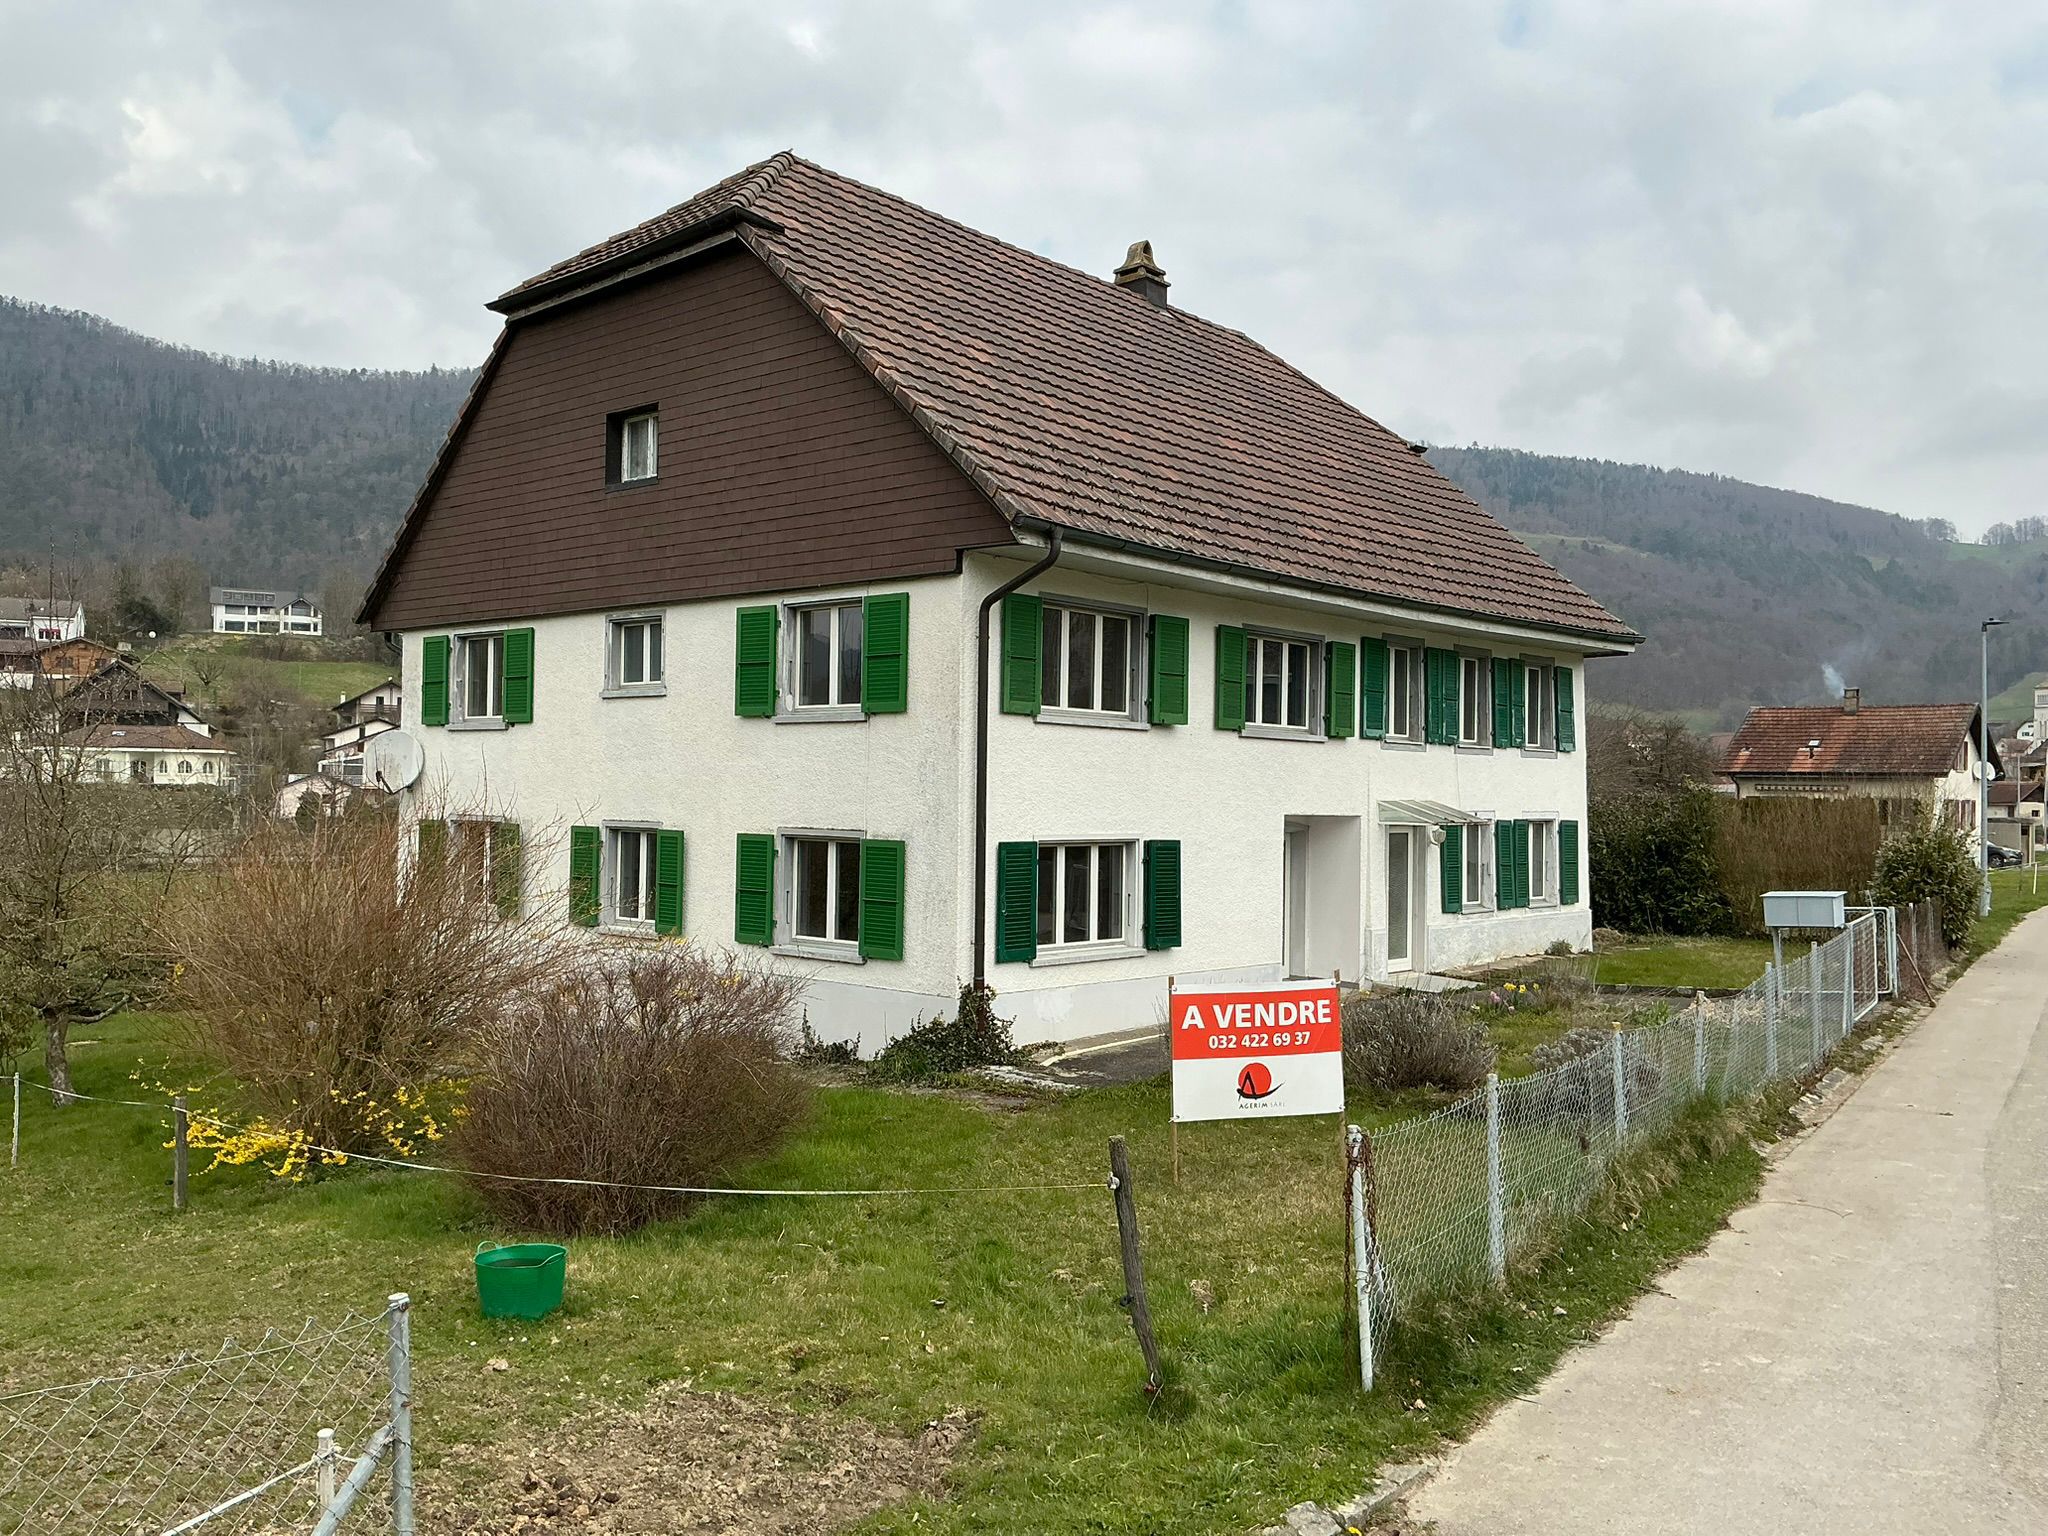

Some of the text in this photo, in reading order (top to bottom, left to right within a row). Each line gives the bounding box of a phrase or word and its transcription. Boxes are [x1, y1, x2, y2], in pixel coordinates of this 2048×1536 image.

[1181, 999, 1332, 1030] A VENDRE
[1208, 1031, 1311, 1049] 032 422 69 37
[1238, 1102, 1268, 1110] AGERIM
